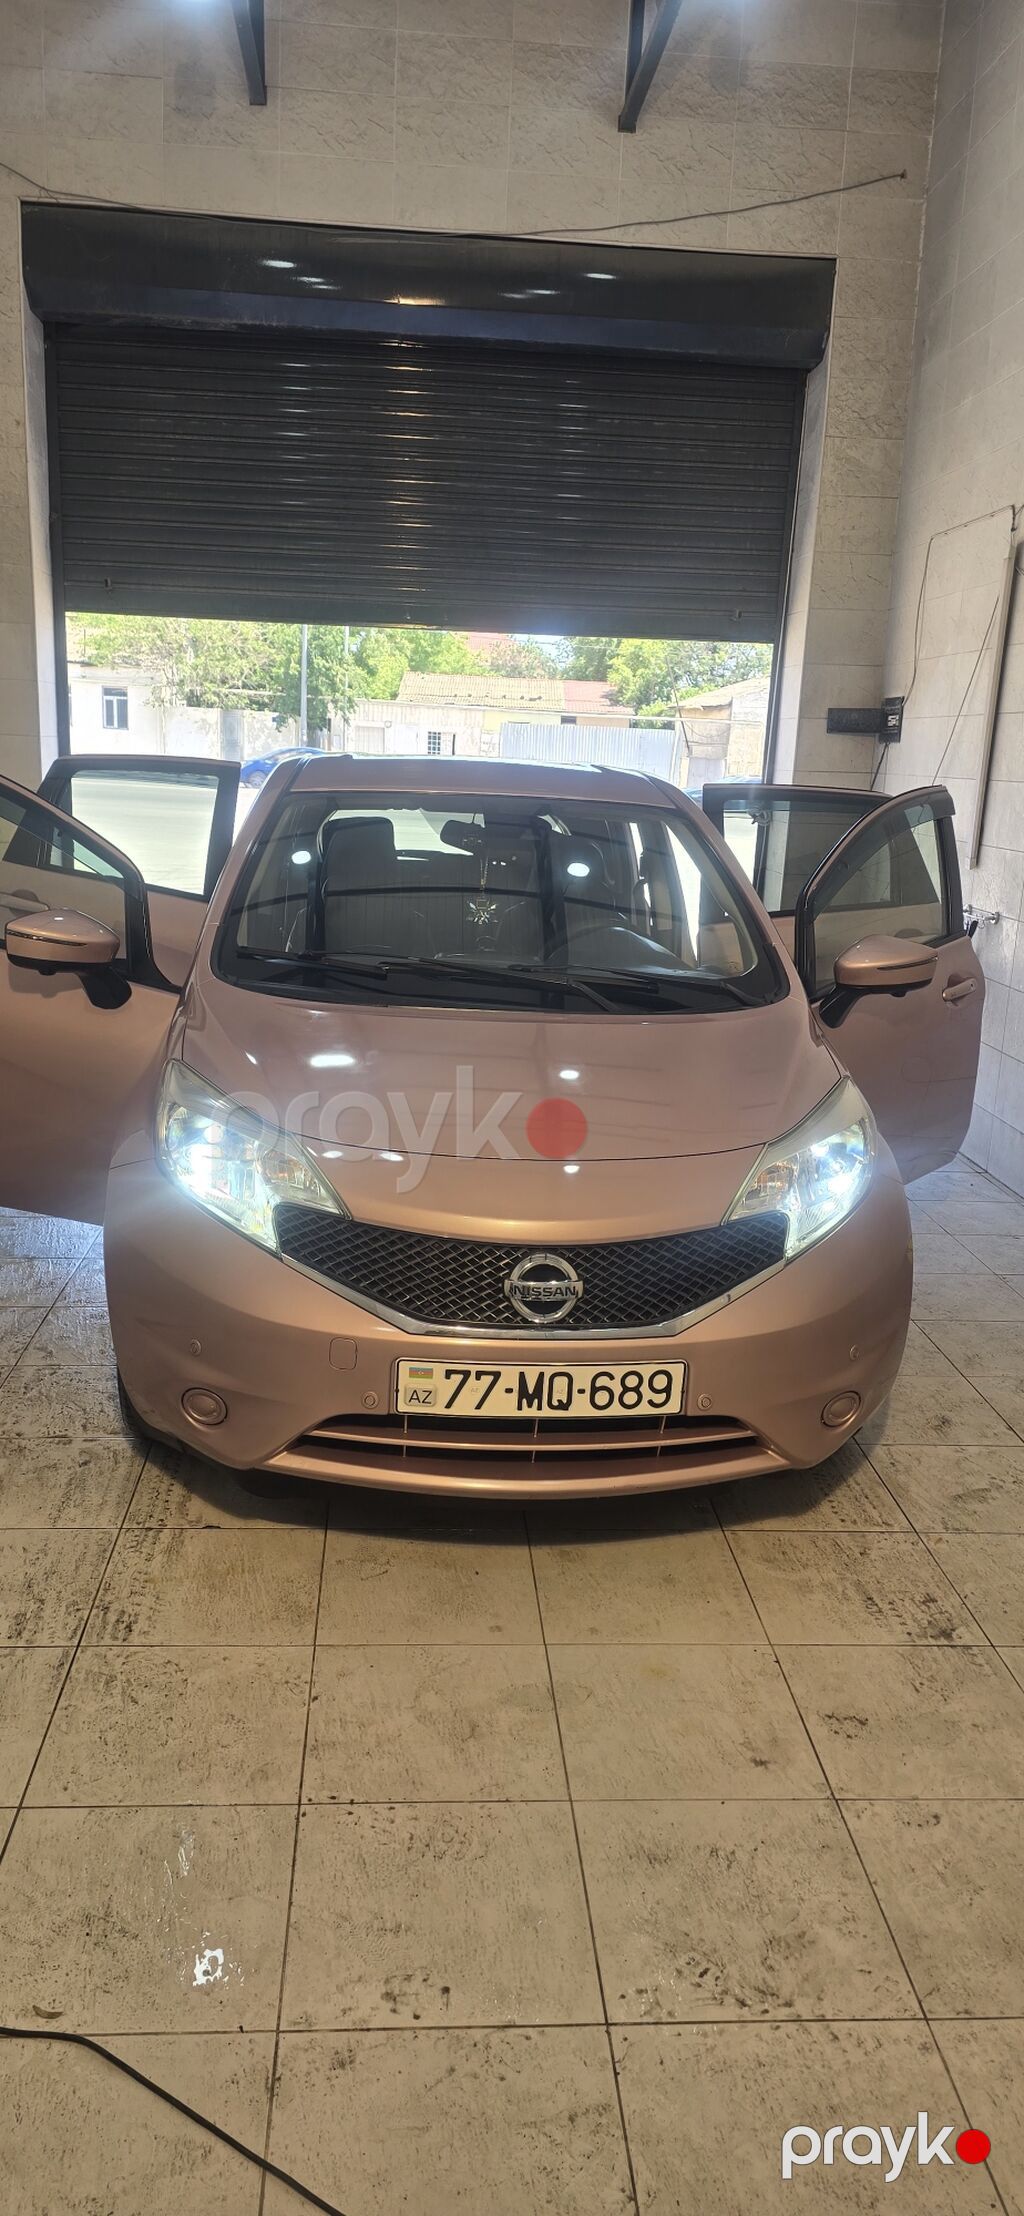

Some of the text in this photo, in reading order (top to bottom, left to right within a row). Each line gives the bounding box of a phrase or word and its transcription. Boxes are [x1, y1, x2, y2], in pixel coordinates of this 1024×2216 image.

[512, 1284, 578, 1297] NISSAN
[408, 1389, 432, 1404] AZ
[444, 1369, 673, 1411] 77-MQ-689
